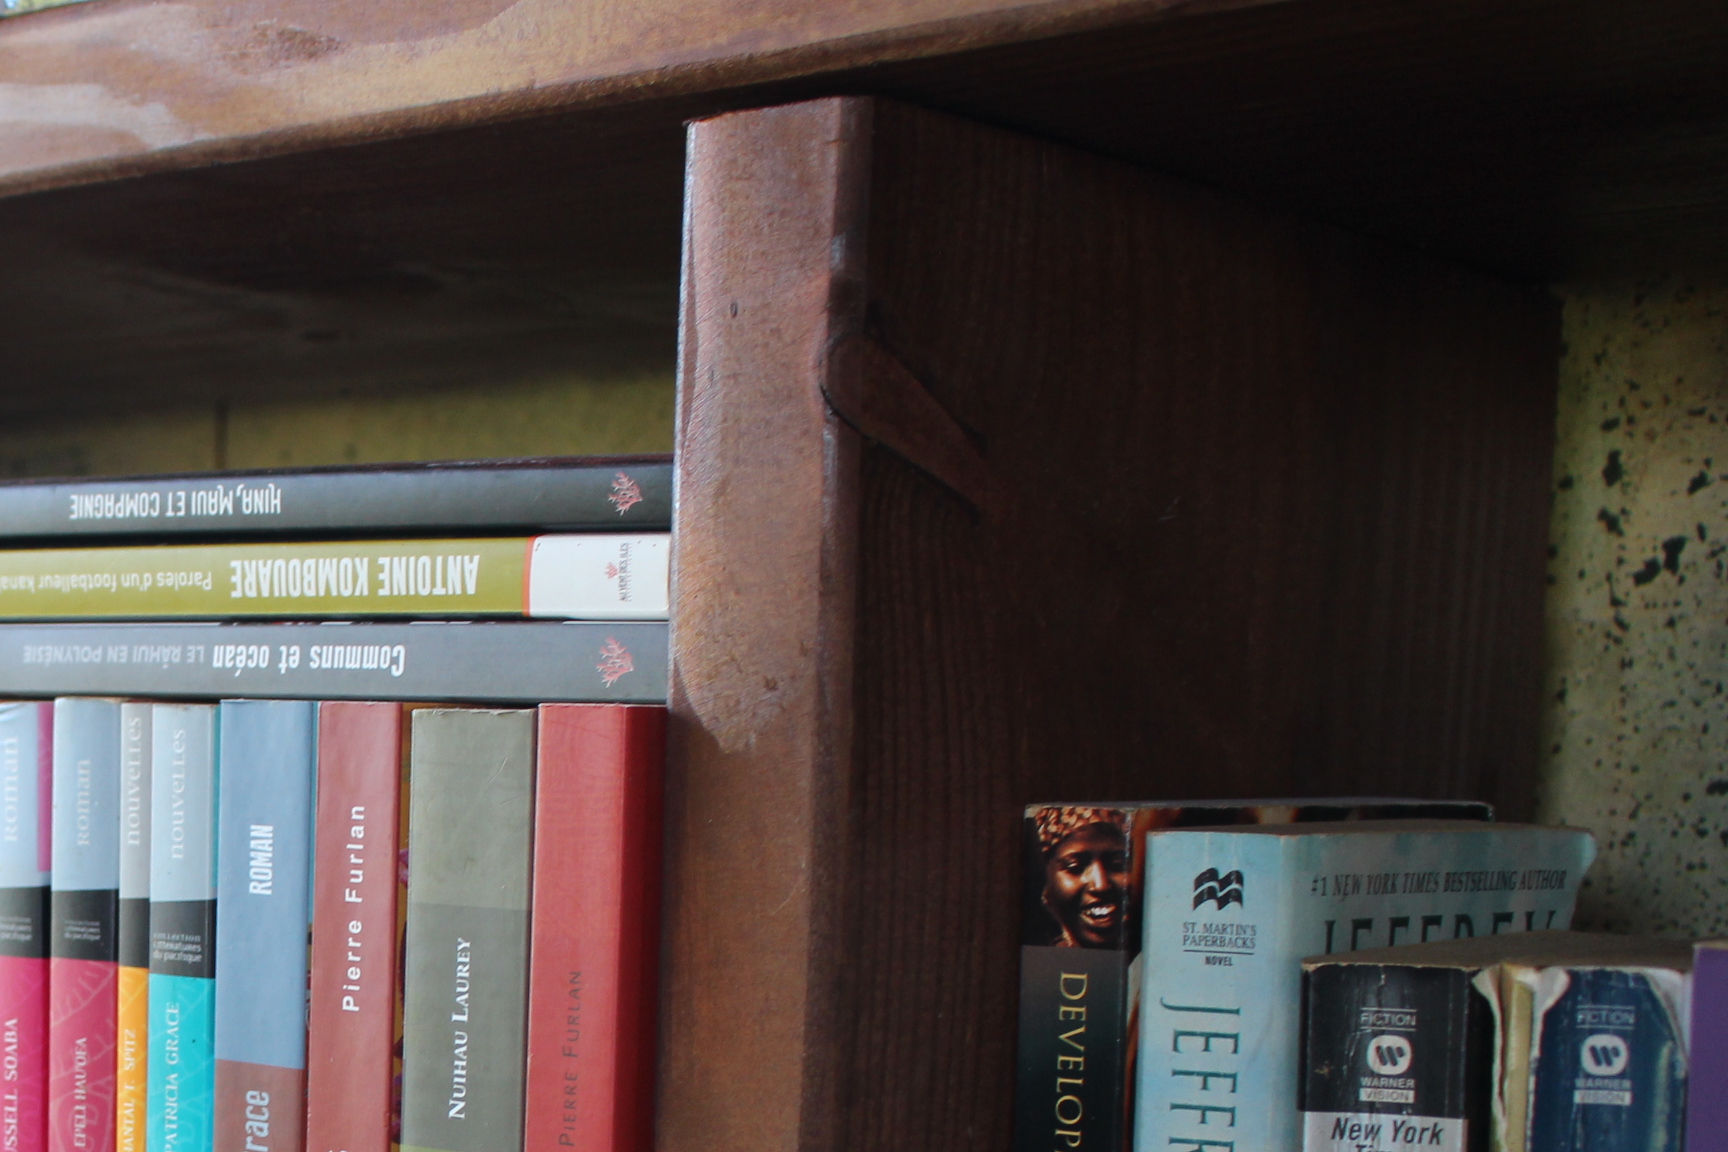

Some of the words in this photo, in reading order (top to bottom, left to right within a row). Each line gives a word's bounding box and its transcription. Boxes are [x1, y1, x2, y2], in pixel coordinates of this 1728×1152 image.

[69, 491, 160, 520] COMPAGNIE
[165, 490, 186, 517] ET
[191, 484, 233, 516] MAUI
[236, 483, 281, 515] HINA,
[39, 572, 117, 593] footballeur
[121, 572, 152, 591] d'un
[156, 570, 212, 591] Paroles
[229, 557, 369, 598] KOMBOUARE
[377, 554, 480, 596] ANTOINE
[107, 645, 129, 664] EN
[187, 645, 204, 664] LE
[213, 644, 270, 677] océan
[278, 644, 300, 674] et
[309, 644, 406, 677] Communs
[249, 824, 274, 896] ROMAN
[345, 805, 365, 903] Furlan
[1310, 875, 1328, 897] #1
[1332, 873, 1364, 896] NEW
[1366, 872, 1398, 896] YORK
[1401, 871, 1440, 894] TIMES
[1443, 869, 1517, 892] BESTSELLING
[1519, 868, 1568, 891] AUTHOR
[1182, 921, 1200, 935] ST.
[1202, 922, 1257, 937] MARTIN'S
[1182, 933, 1257, 950] PAPERBACKS
[342, 919, 363, 1012] Pierre
[1204, 955, 1234, 967] NOVEL
[451, 937, 471, 1023] LAUREY
[562, 970, 582, 1059] FURLAN
[1360, 1011, 1417, 1027] FICTION
[1576, 1009, 1635, 1026] FICTION
[165, 1001, 180, 1066] GRACE
[3, 1018, 18, 1082] SOABA
[124, 1028, 137, 1072] SPITZ
[448, 1030, 468, 1120] NUIHAU
[1360, 1077, 1415, 1089] WARNER
[1575, 1077, 1633, 1091] WARNER
[559, 1071, 579, 1147] PIERRE
[1364, 1089, 1409, 1102] VISION
[74, 1104, 87, 1148] EPELI
[1331, 1116, 1381, 1143] New
[1391, 1118, 1444, 1146] York
